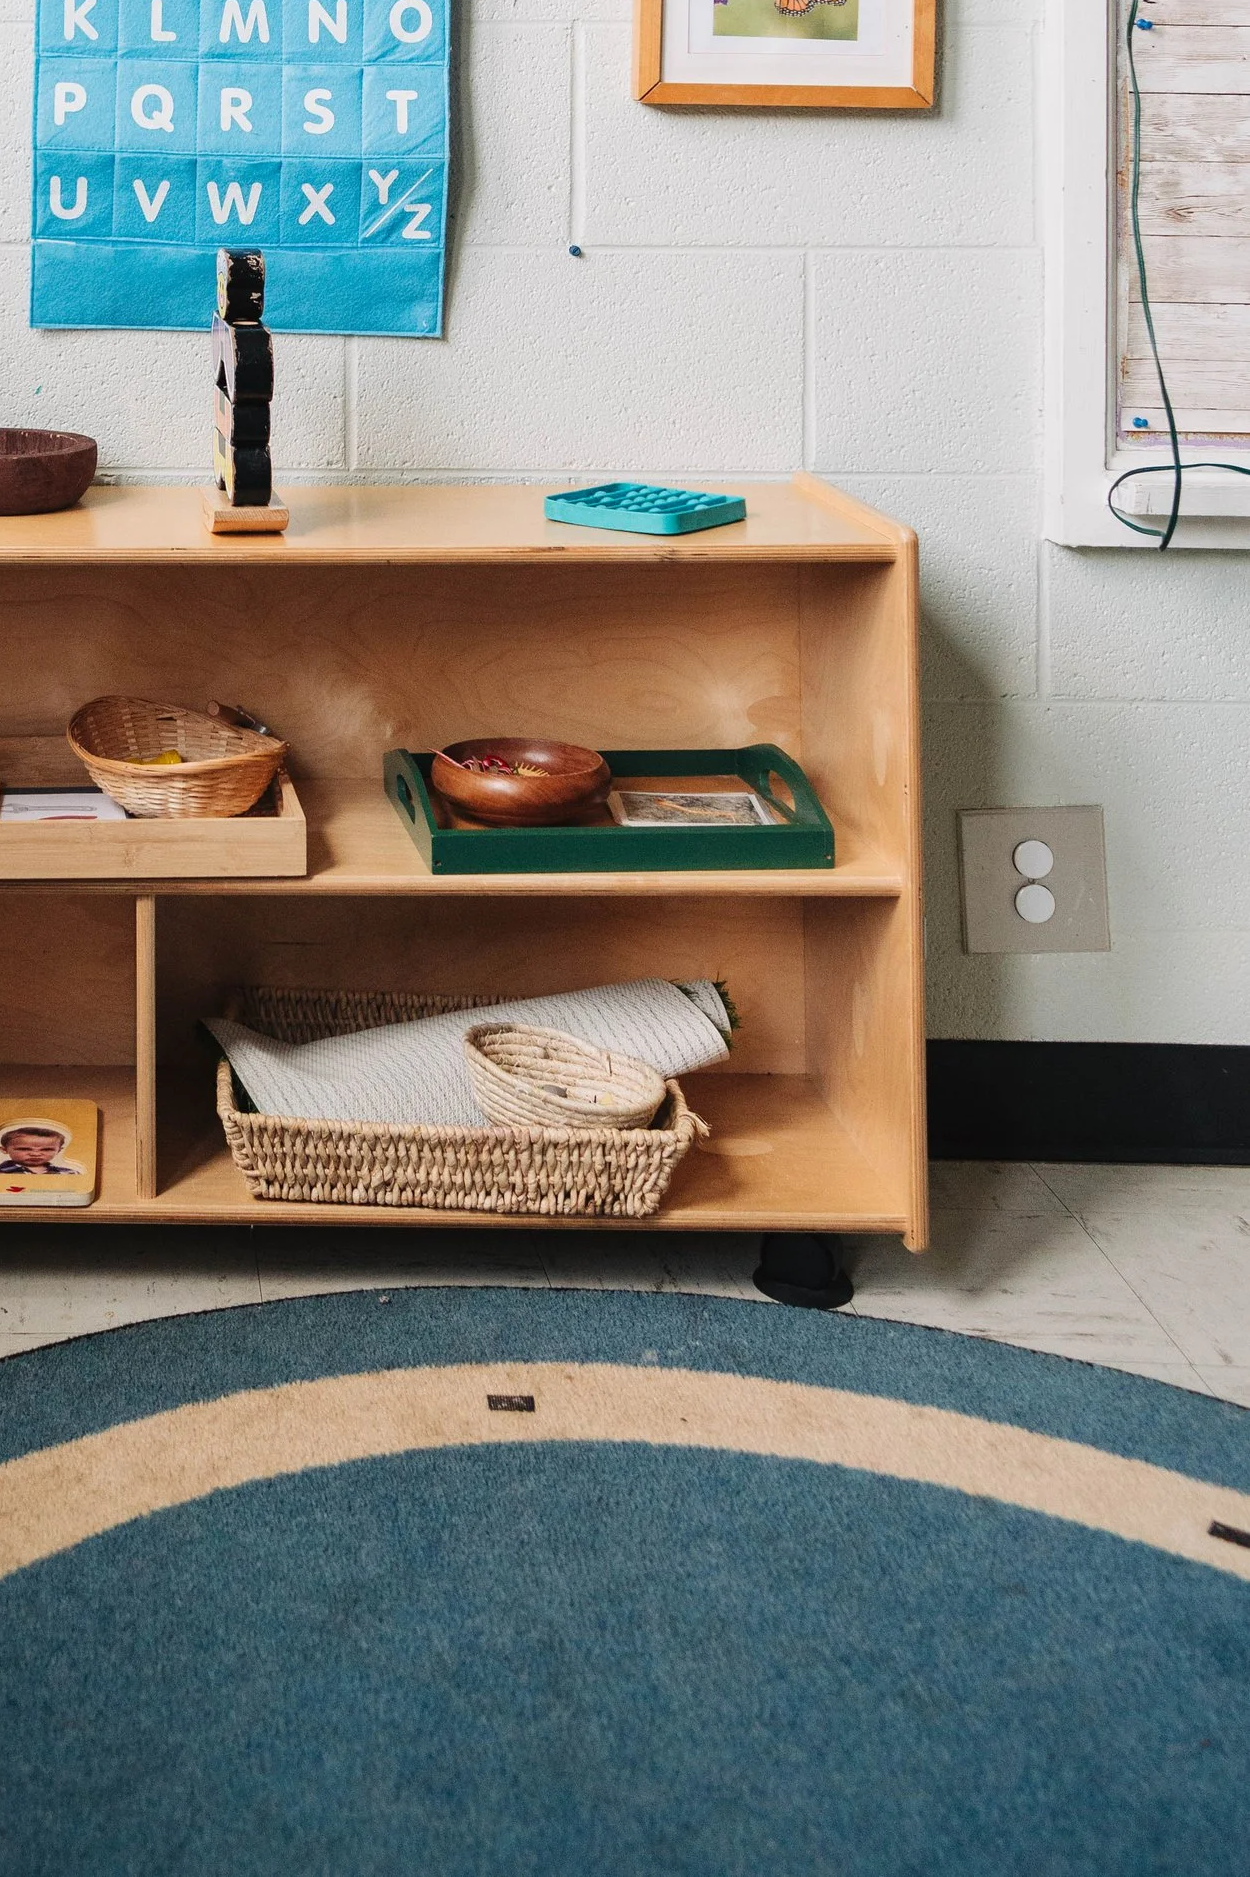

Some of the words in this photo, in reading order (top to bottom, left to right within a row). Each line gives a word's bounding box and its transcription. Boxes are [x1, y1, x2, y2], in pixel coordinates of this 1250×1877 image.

[54, 82, 88, 126] P
[130, 84, 175, 133] Q
[220, 87, 253, 132] R
[303, 88, 336, 134] S
[386, 89, 419, 134] T
[50, 176, 88, 219] U
[133, 178, 170, 223] V
[207, 181, 263, 225] W
[298, 182, 336, 225] X
